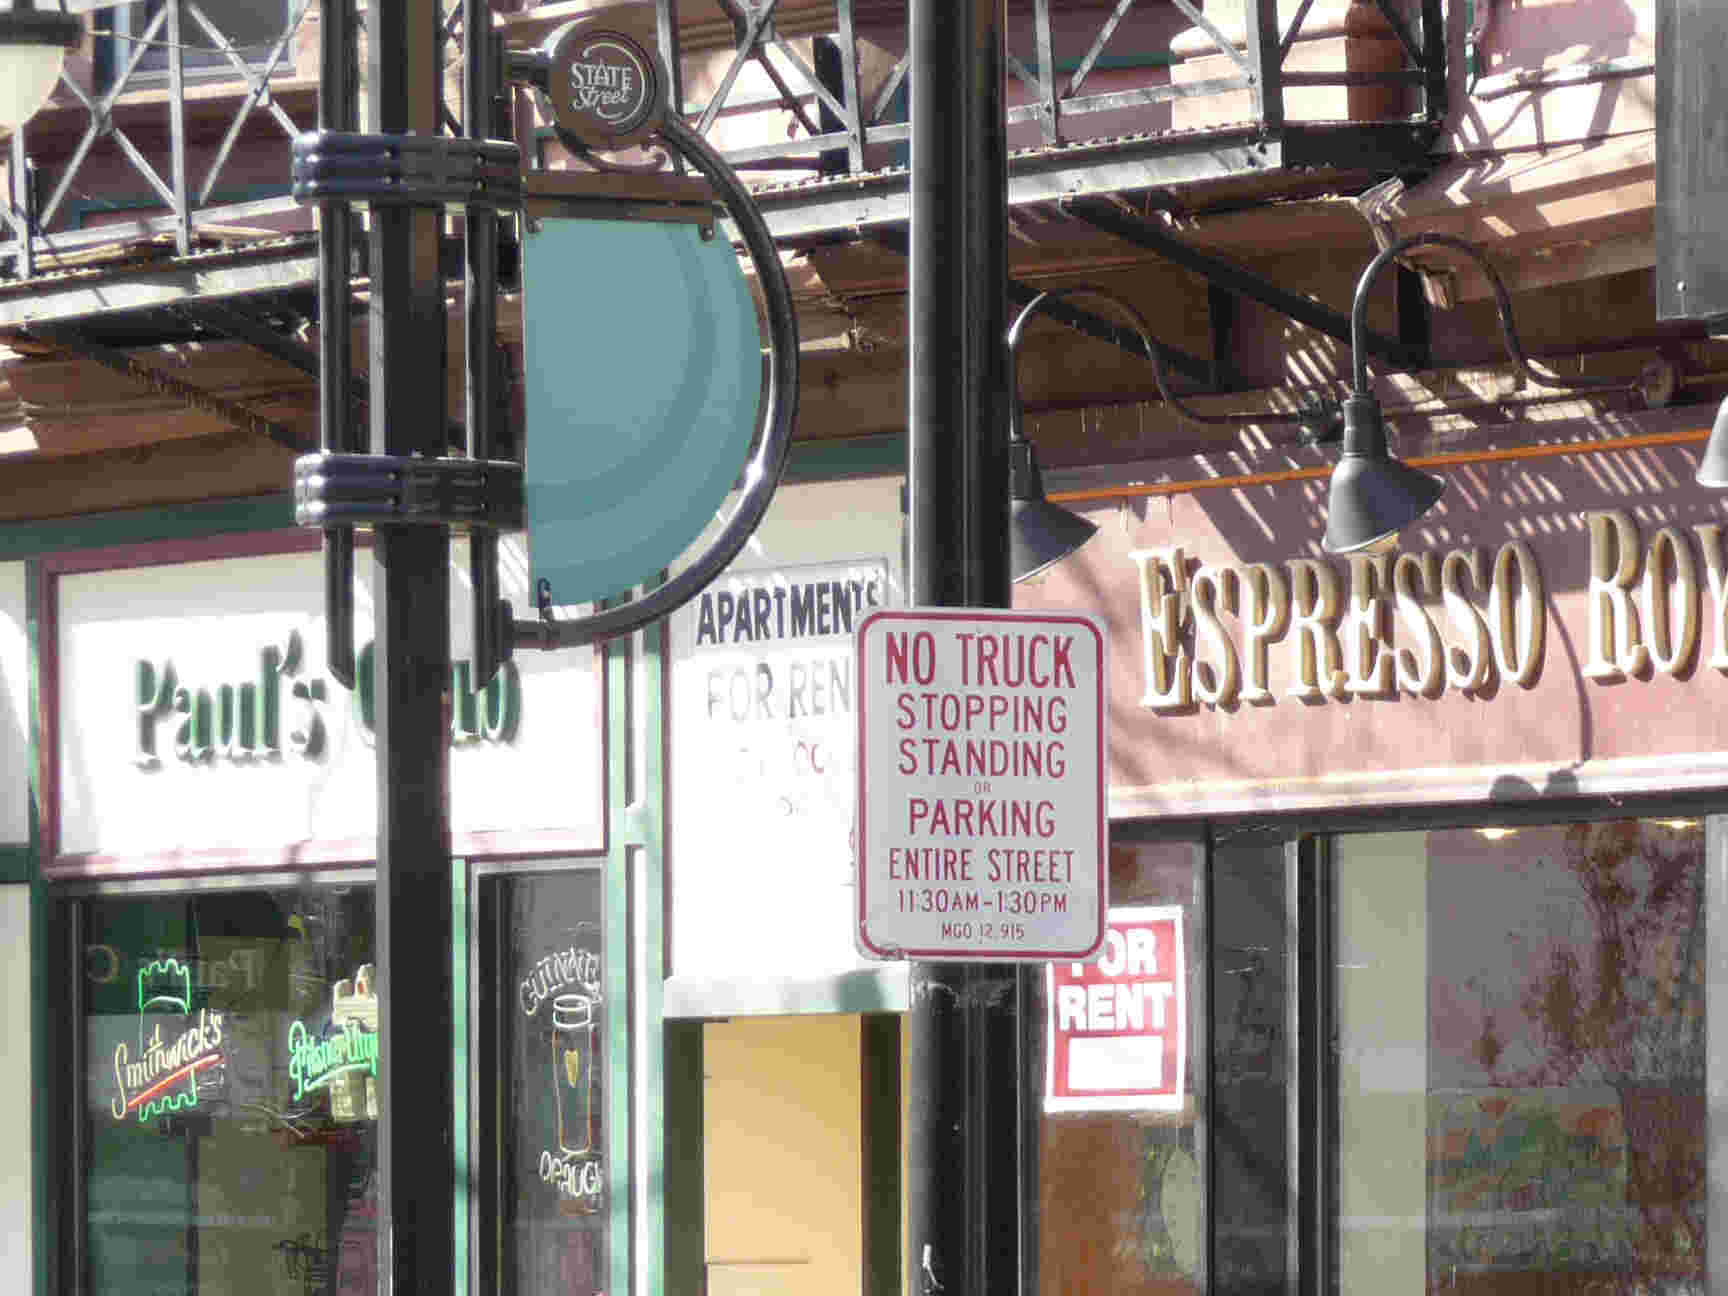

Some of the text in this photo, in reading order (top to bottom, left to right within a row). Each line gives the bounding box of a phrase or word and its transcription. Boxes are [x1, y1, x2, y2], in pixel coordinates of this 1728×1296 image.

[571, 62, 632, 89] STATE
[696, 578, 880, 645] APARTMENTS
[1130, 538, 1546, 714] ESPRESSO
[885, 631, 1076, 689] NO TRUCK
[136, 628, 327, 772] Paul's
[789, 656, 852, 718] REN
[897, 693, 1067, 733] STOPPING
[898, 738, 1066, 779] STANDING
[974, 781, 992, 794] OR
[908, 799, 1057, 838] PARKING
[889, 848, 1075, 883] ENTIRE STREET
[941, 922, 972, 941] MGO
[1058, 982, 1175, 1033] RENT
[112, 1007, 222, 1120] Smithwick's
